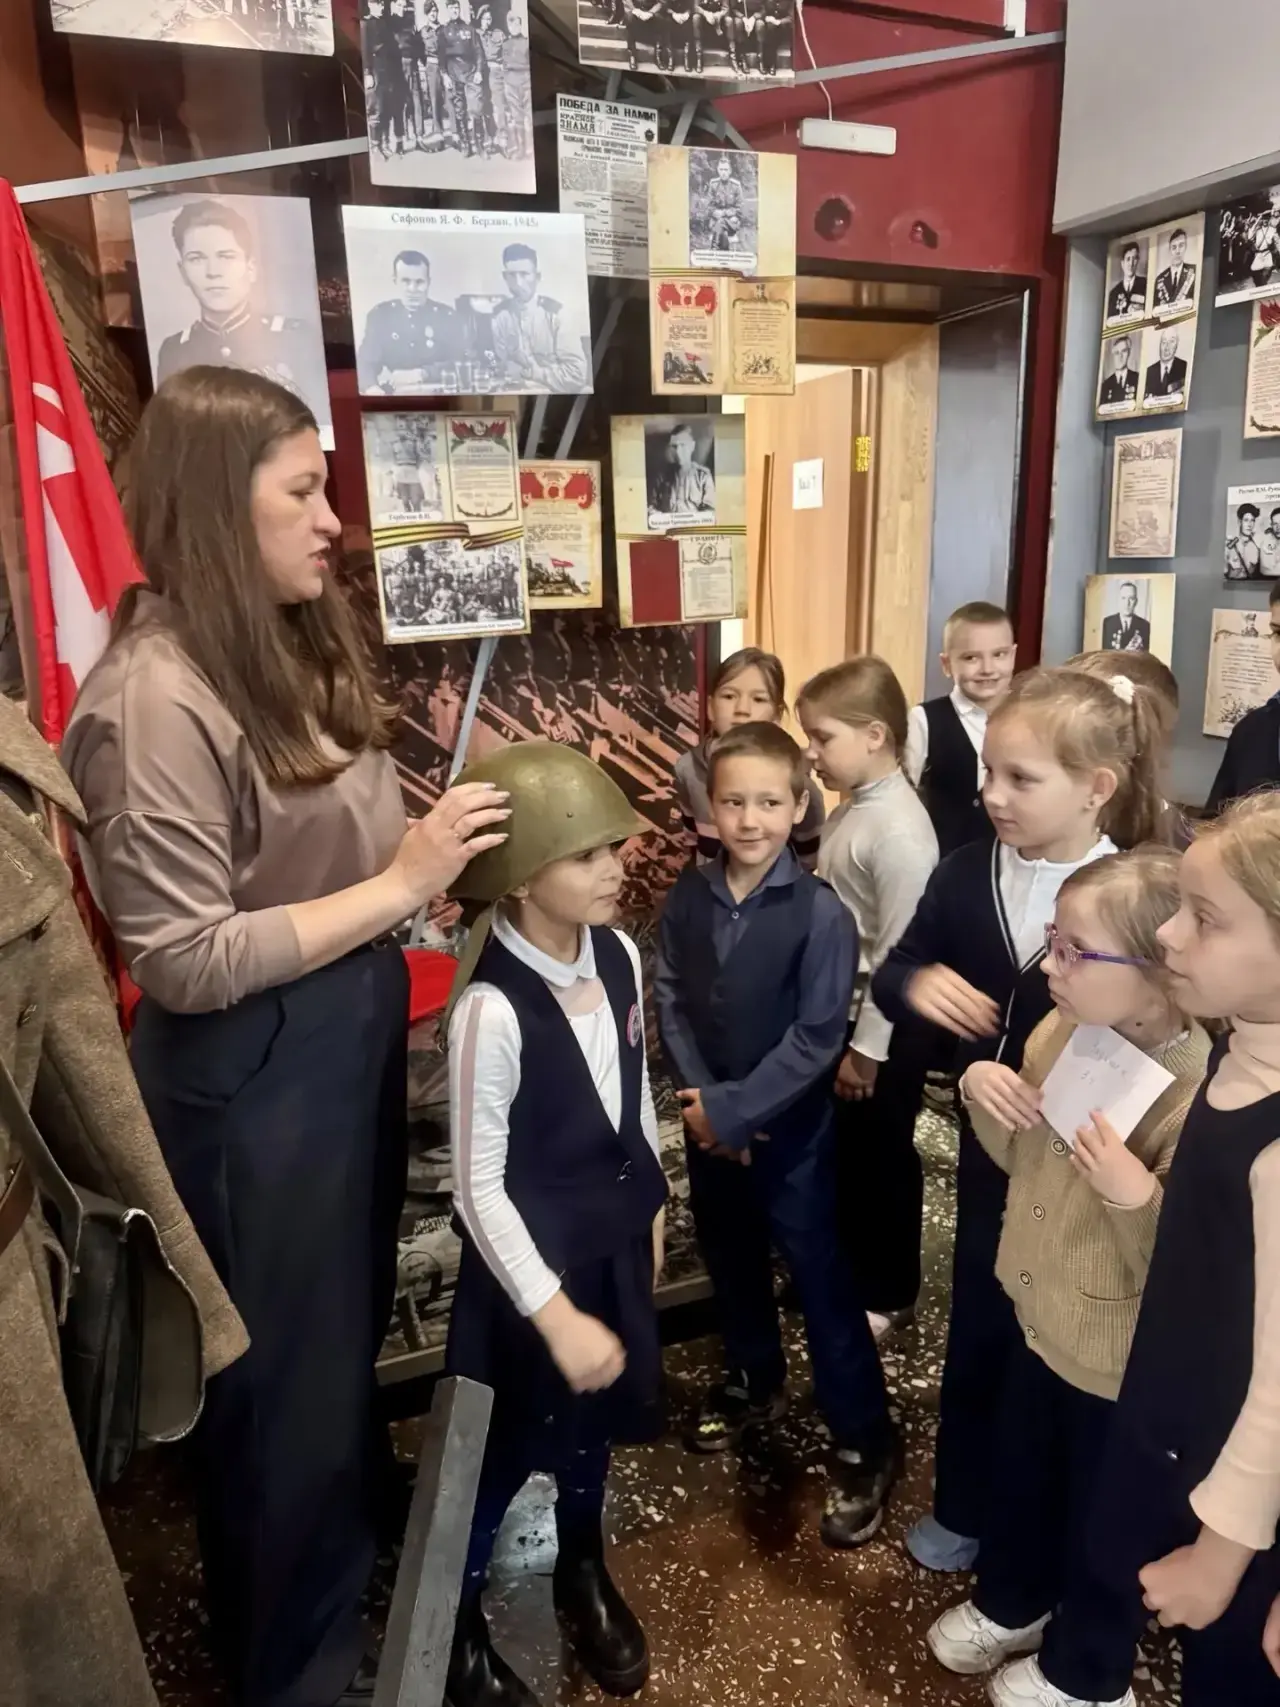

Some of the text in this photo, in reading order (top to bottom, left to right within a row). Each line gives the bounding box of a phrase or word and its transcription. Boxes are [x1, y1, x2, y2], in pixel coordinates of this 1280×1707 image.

[560, 97, 600, 113] ПОБЕДА
[605, 104, 620, 116] ЗА
[560, 119, 596, 133] ЗНАМЯ
[391, 213, 437, 226] Сафонов
[440, 215, 451, 225] Я.
